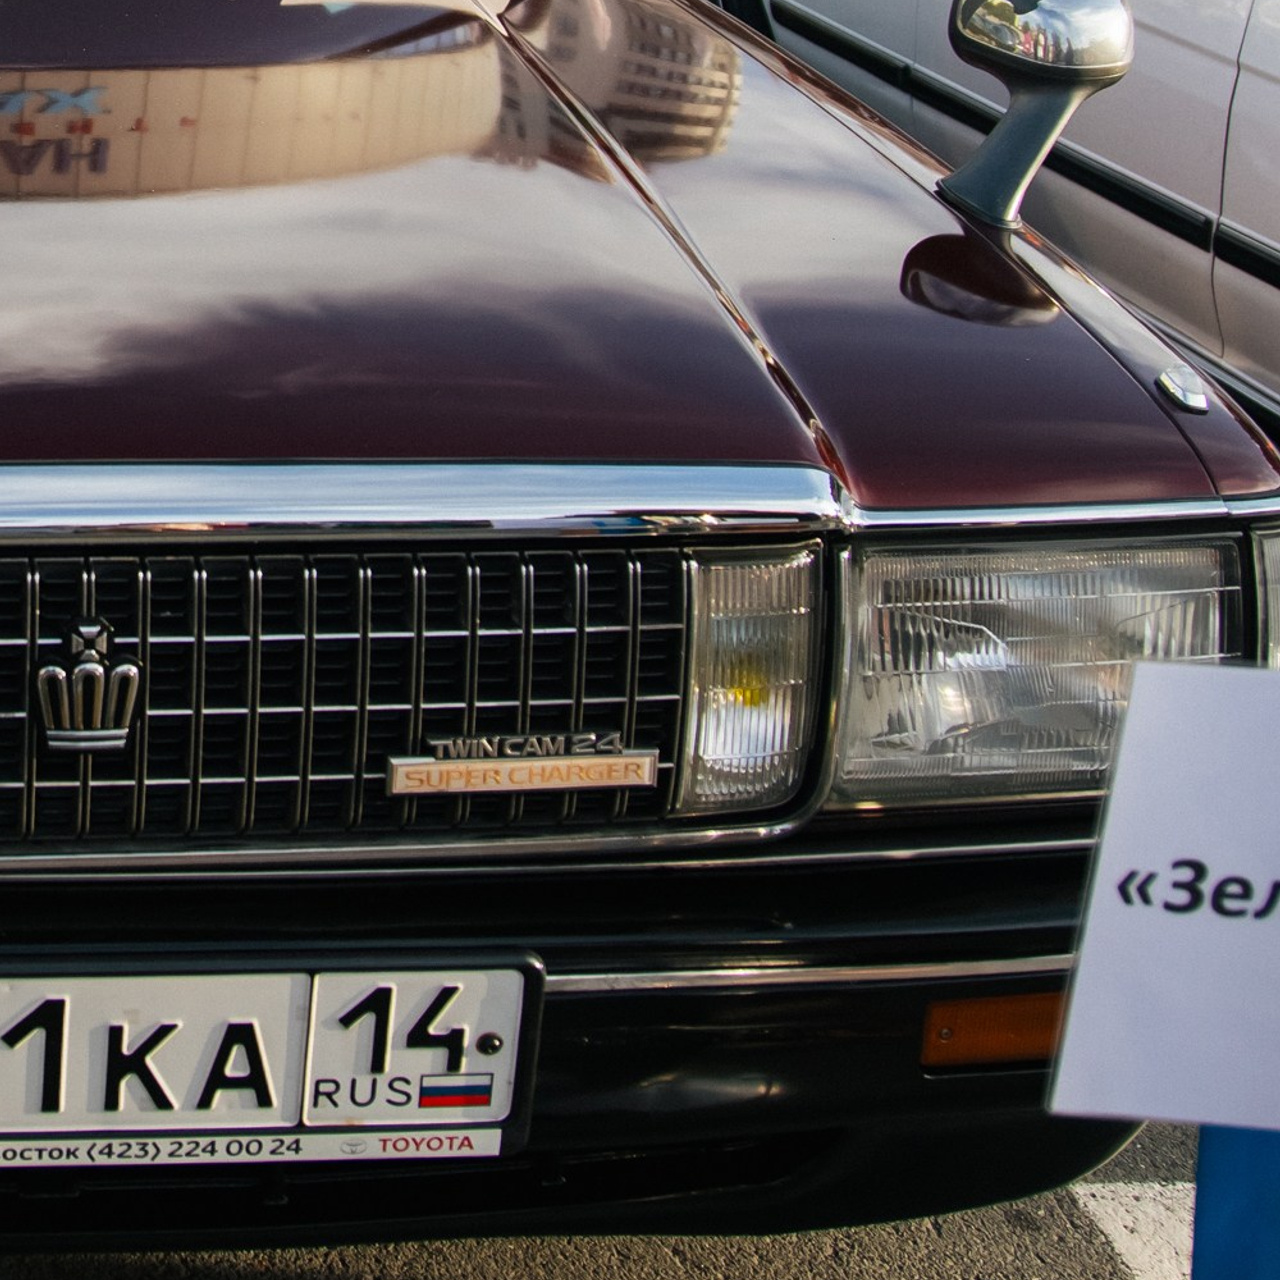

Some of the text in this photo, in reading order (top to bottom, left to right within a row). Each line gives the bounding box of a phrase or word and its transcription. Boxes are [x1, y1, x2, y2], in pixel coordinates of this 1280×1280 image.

[427, 732, 624, 759] TWIN CAM 24
[337, 984, 466, 1074] 14
[313, 1076, 413, 1108] RUS
[167, 1138, 218, 1159] 224
[225, 1138, 264, 1157] 00
[269, 1137, 303, 1156] 24
[378, 1134, 475, 1154] TOYOTA
